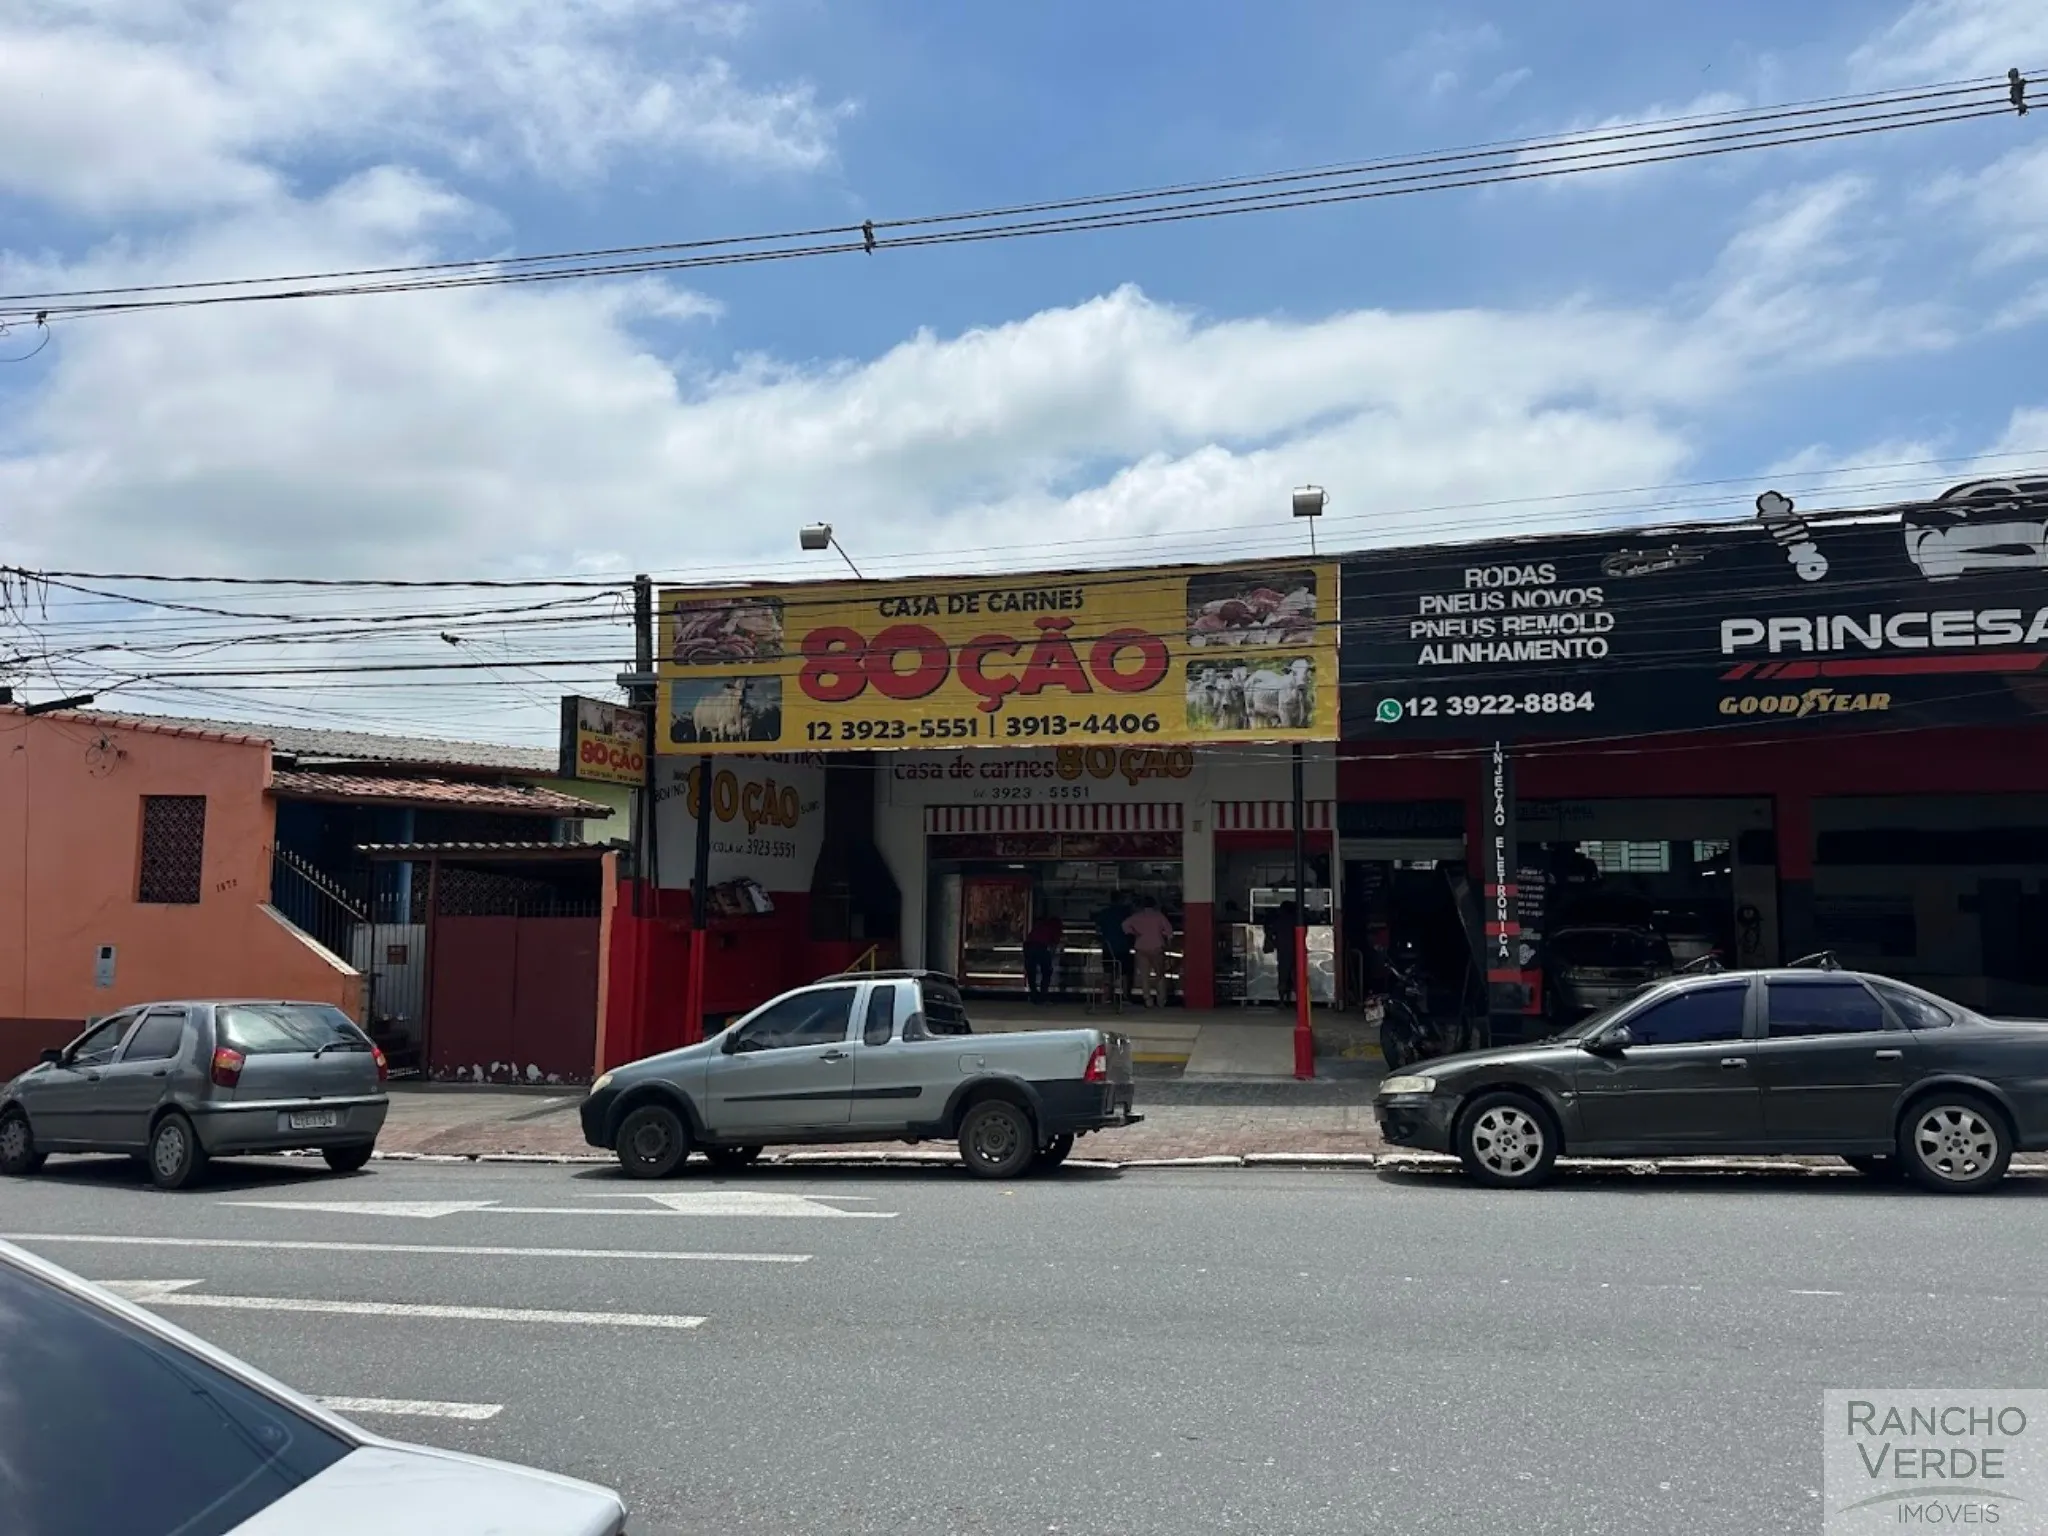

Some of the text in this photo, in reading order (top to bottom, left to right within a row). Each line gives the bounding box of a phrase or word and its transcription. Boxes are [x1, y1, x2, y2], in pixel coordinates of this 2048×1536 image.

[1465, 563, 1557, 588] RODAS
[878, 588, 1084, 619] CASA DE CARNES
[1419, 586, 1604, 615] PNEUS NOVOS
[1410, 611, 1615, 639] PNEUS REMOLD
[1417, 637, 1609, 666] ALINHAMENTO
[1405, 691, 1595, 717] 12 3922-8884
[807, 721, 832, 742] 12
[841, 717, 978, 740] 3923-5551
[1006, 713, 1160, 737] 3913-4406
[895, 760, 943, 780] casa
[948, 755, 974, 780] de
[979, 759, 1055, 780] carnes
